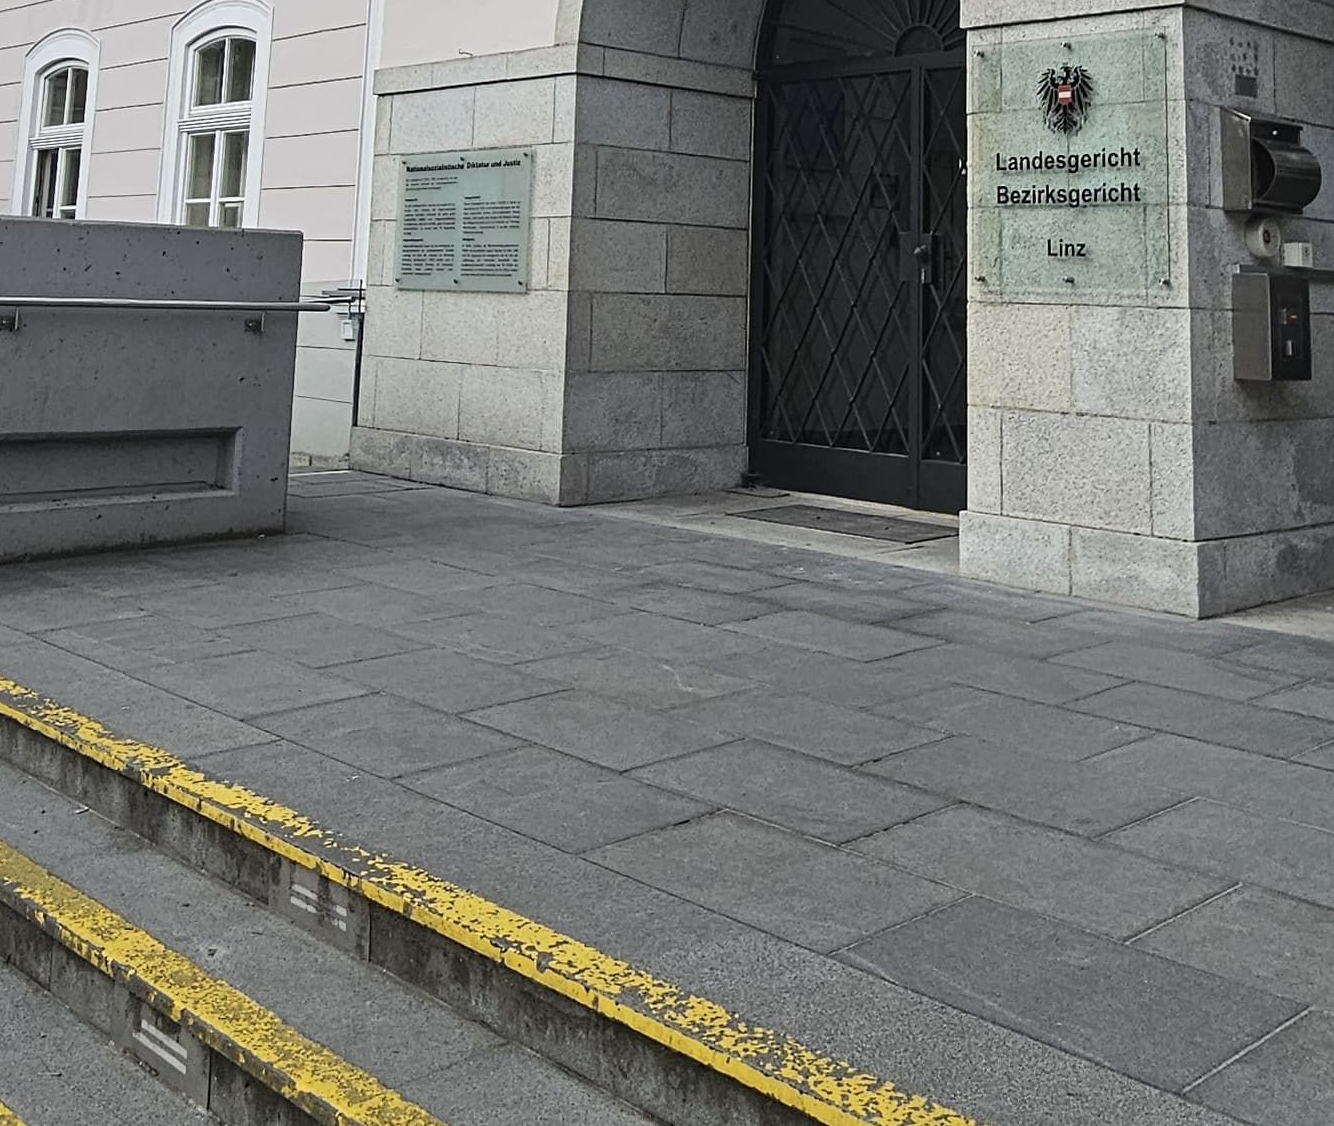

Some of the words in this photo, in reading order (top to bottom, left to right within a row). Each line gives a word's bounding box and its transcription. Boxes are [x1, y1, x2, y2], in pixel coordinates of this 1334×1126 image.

[995, 146, 1141, 174] Landesgericht
[996, 181, 1141, 208] Bezirksgericht
[1046, 238, 1086, 258] Linz
